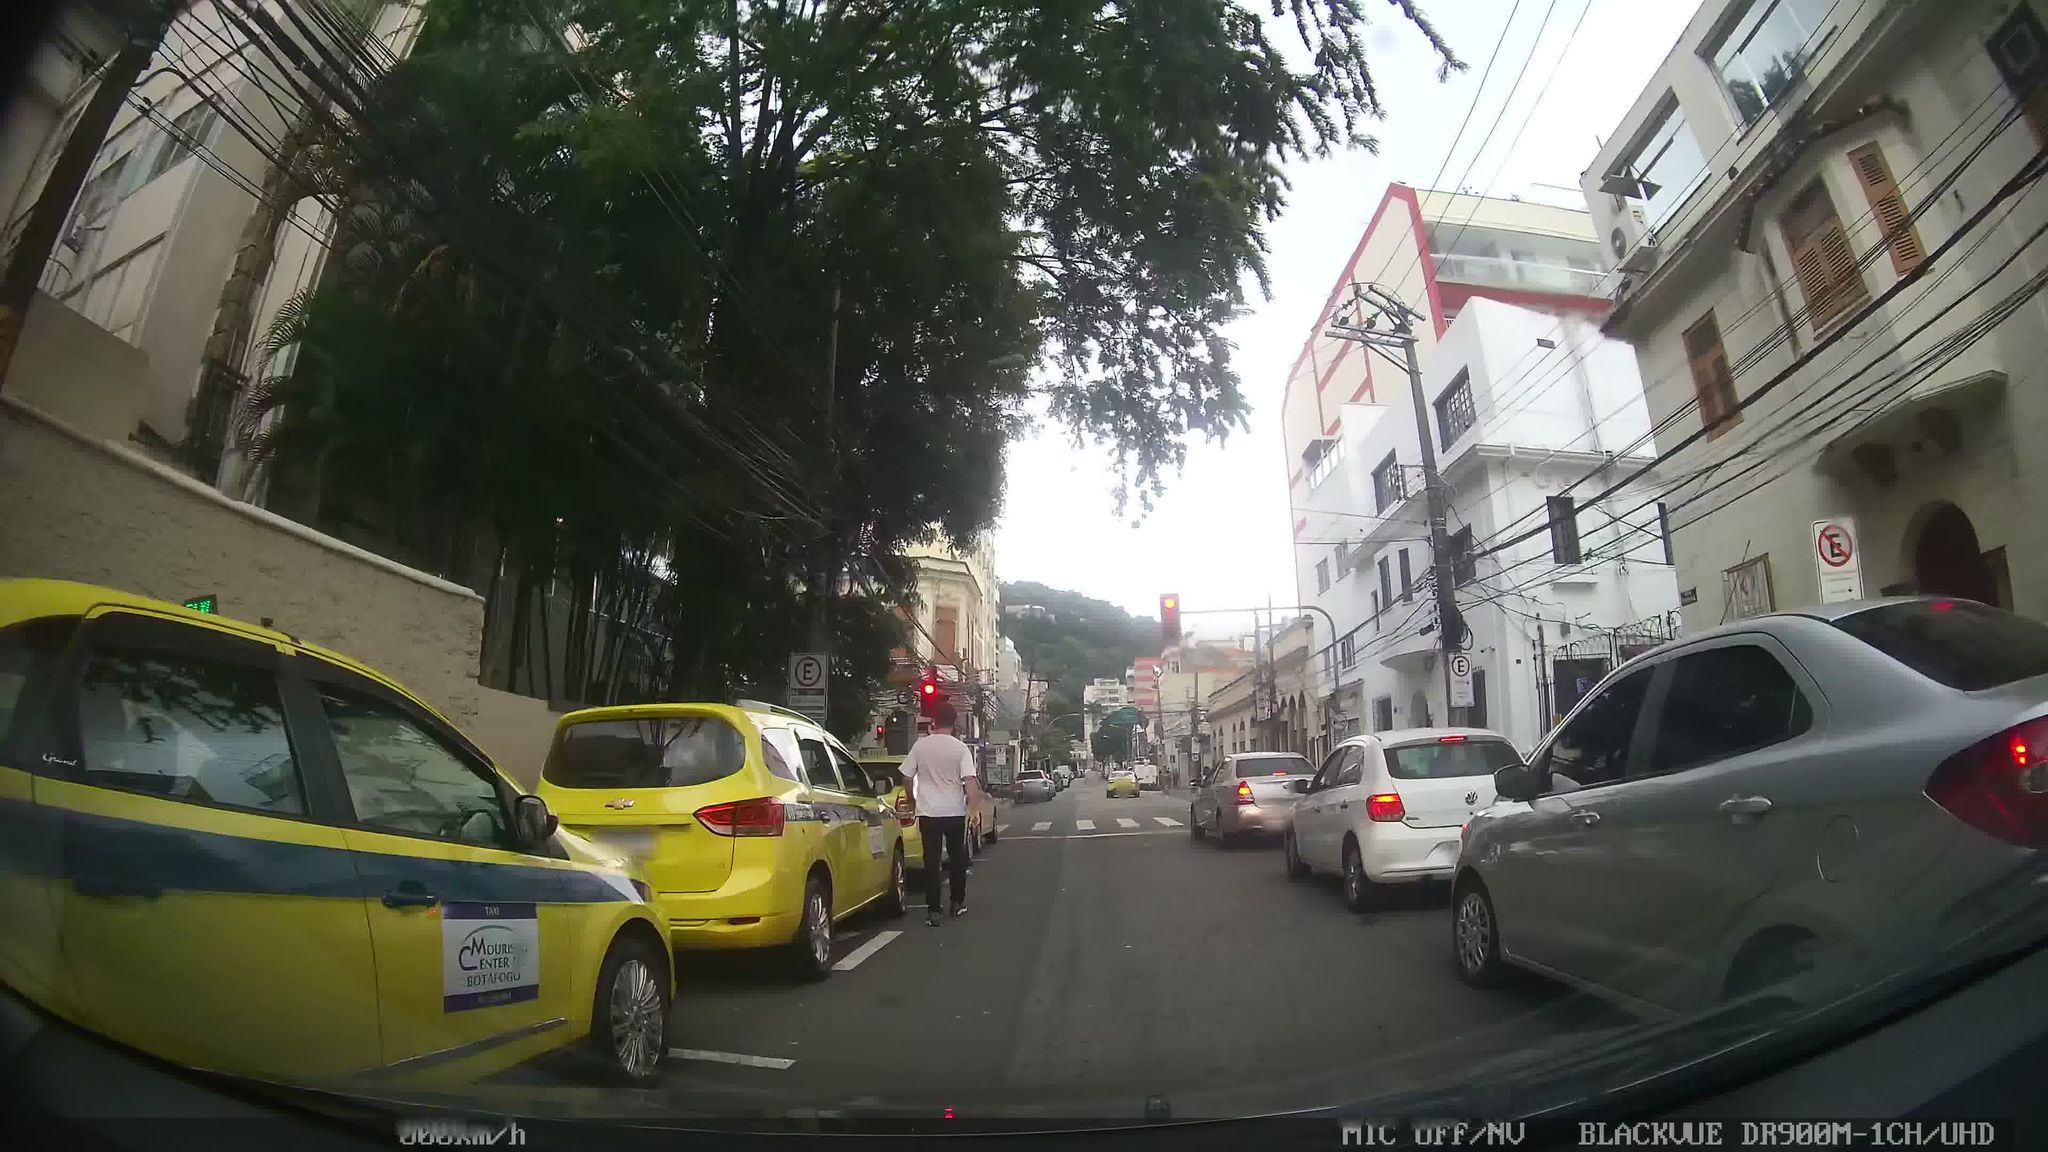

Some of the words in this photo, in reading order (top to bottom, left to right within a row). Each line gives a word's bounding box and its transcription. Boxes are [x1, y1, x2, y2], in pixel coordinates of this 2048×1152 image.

[803, 661, 814, 681] E
[1457, 660, 1465, 673] E
[484, 906, 501, 917] TAXI
